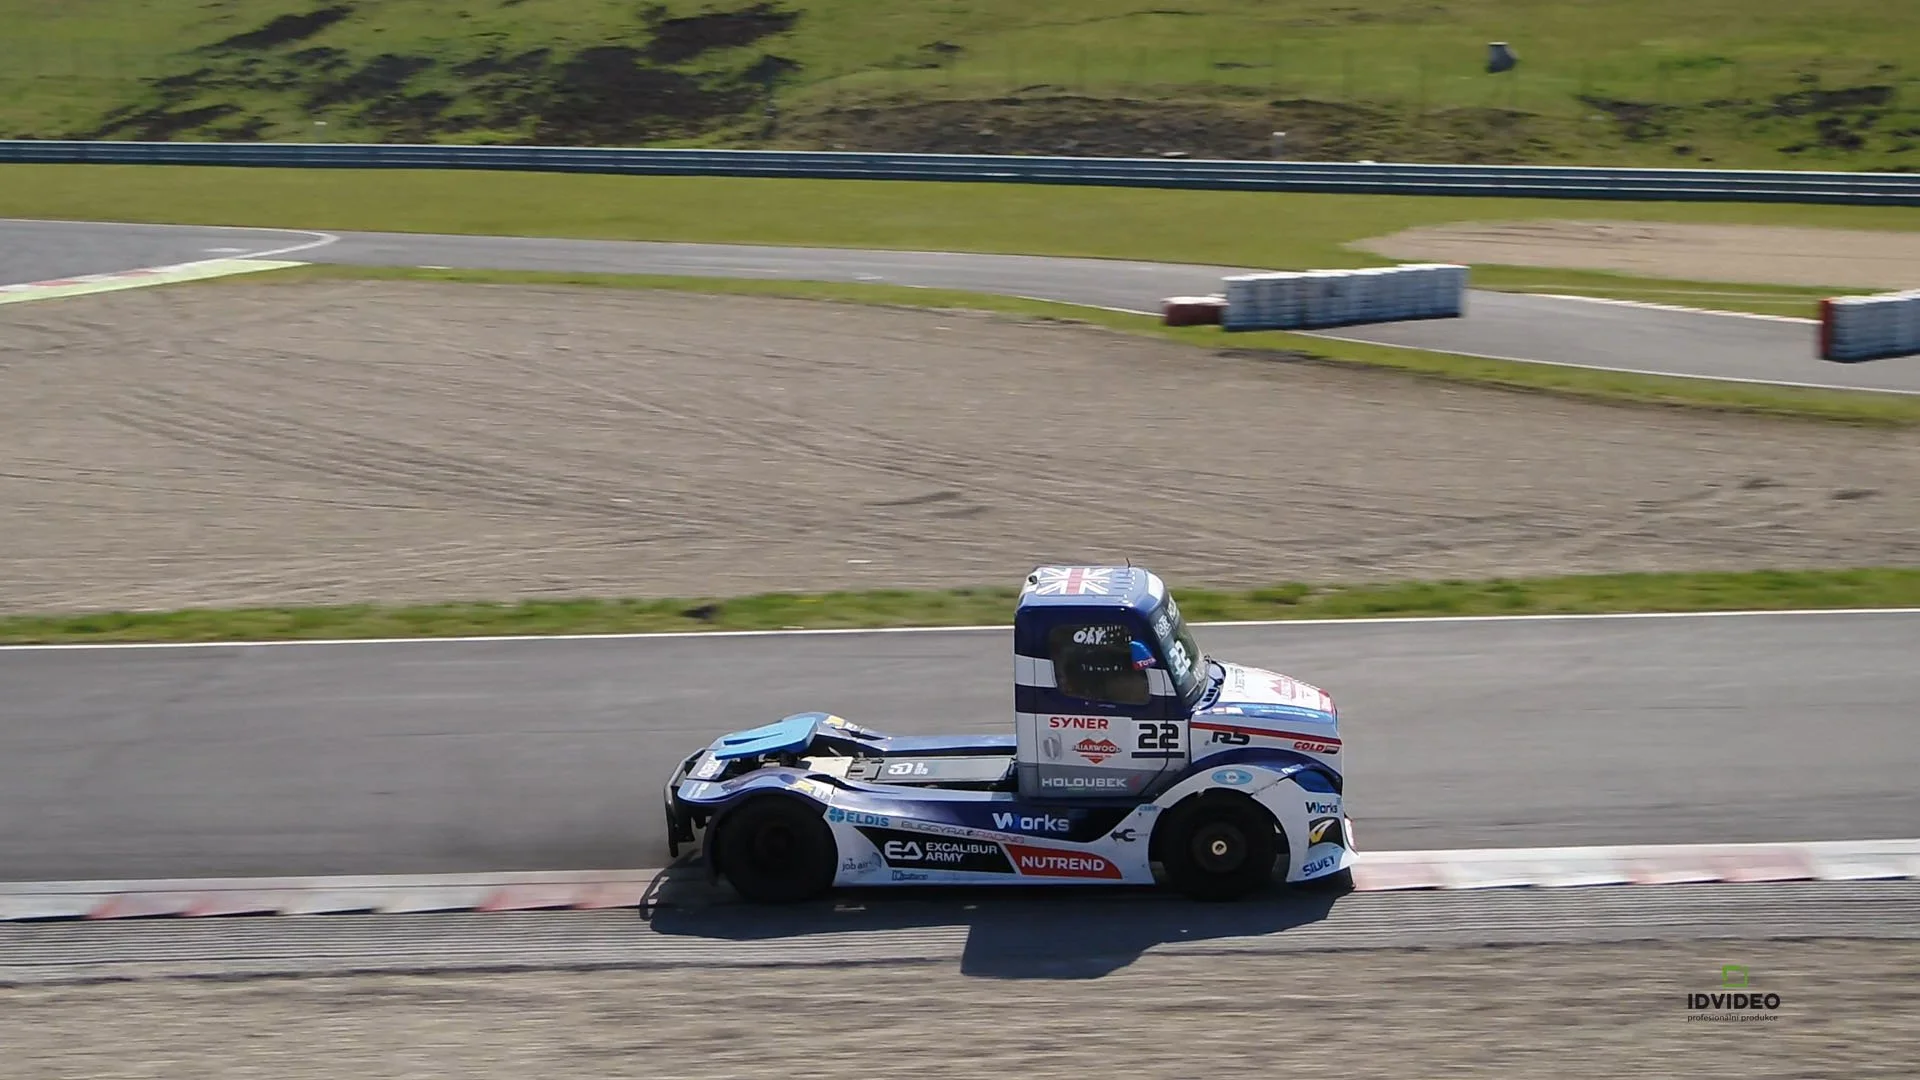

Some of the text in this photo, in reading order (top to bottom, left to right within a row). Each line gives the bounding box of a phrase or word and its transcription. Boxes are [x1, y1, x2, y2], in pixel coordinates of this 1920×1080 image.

[1050, 717, 1109, 730] SYNER
[1138, 723, 1179, 749] 22
[1041, 777, 1128, 788] HOLOUBEK
[846, 812, 889, 827] ELDIS
[925, 841, 998, 855] EXCALIBUR
[925, 852, 963, 863] ARMY
[1021, 855, 1105, 872] NUTREND
[1302, 855, 1335, 877] SILVEY
